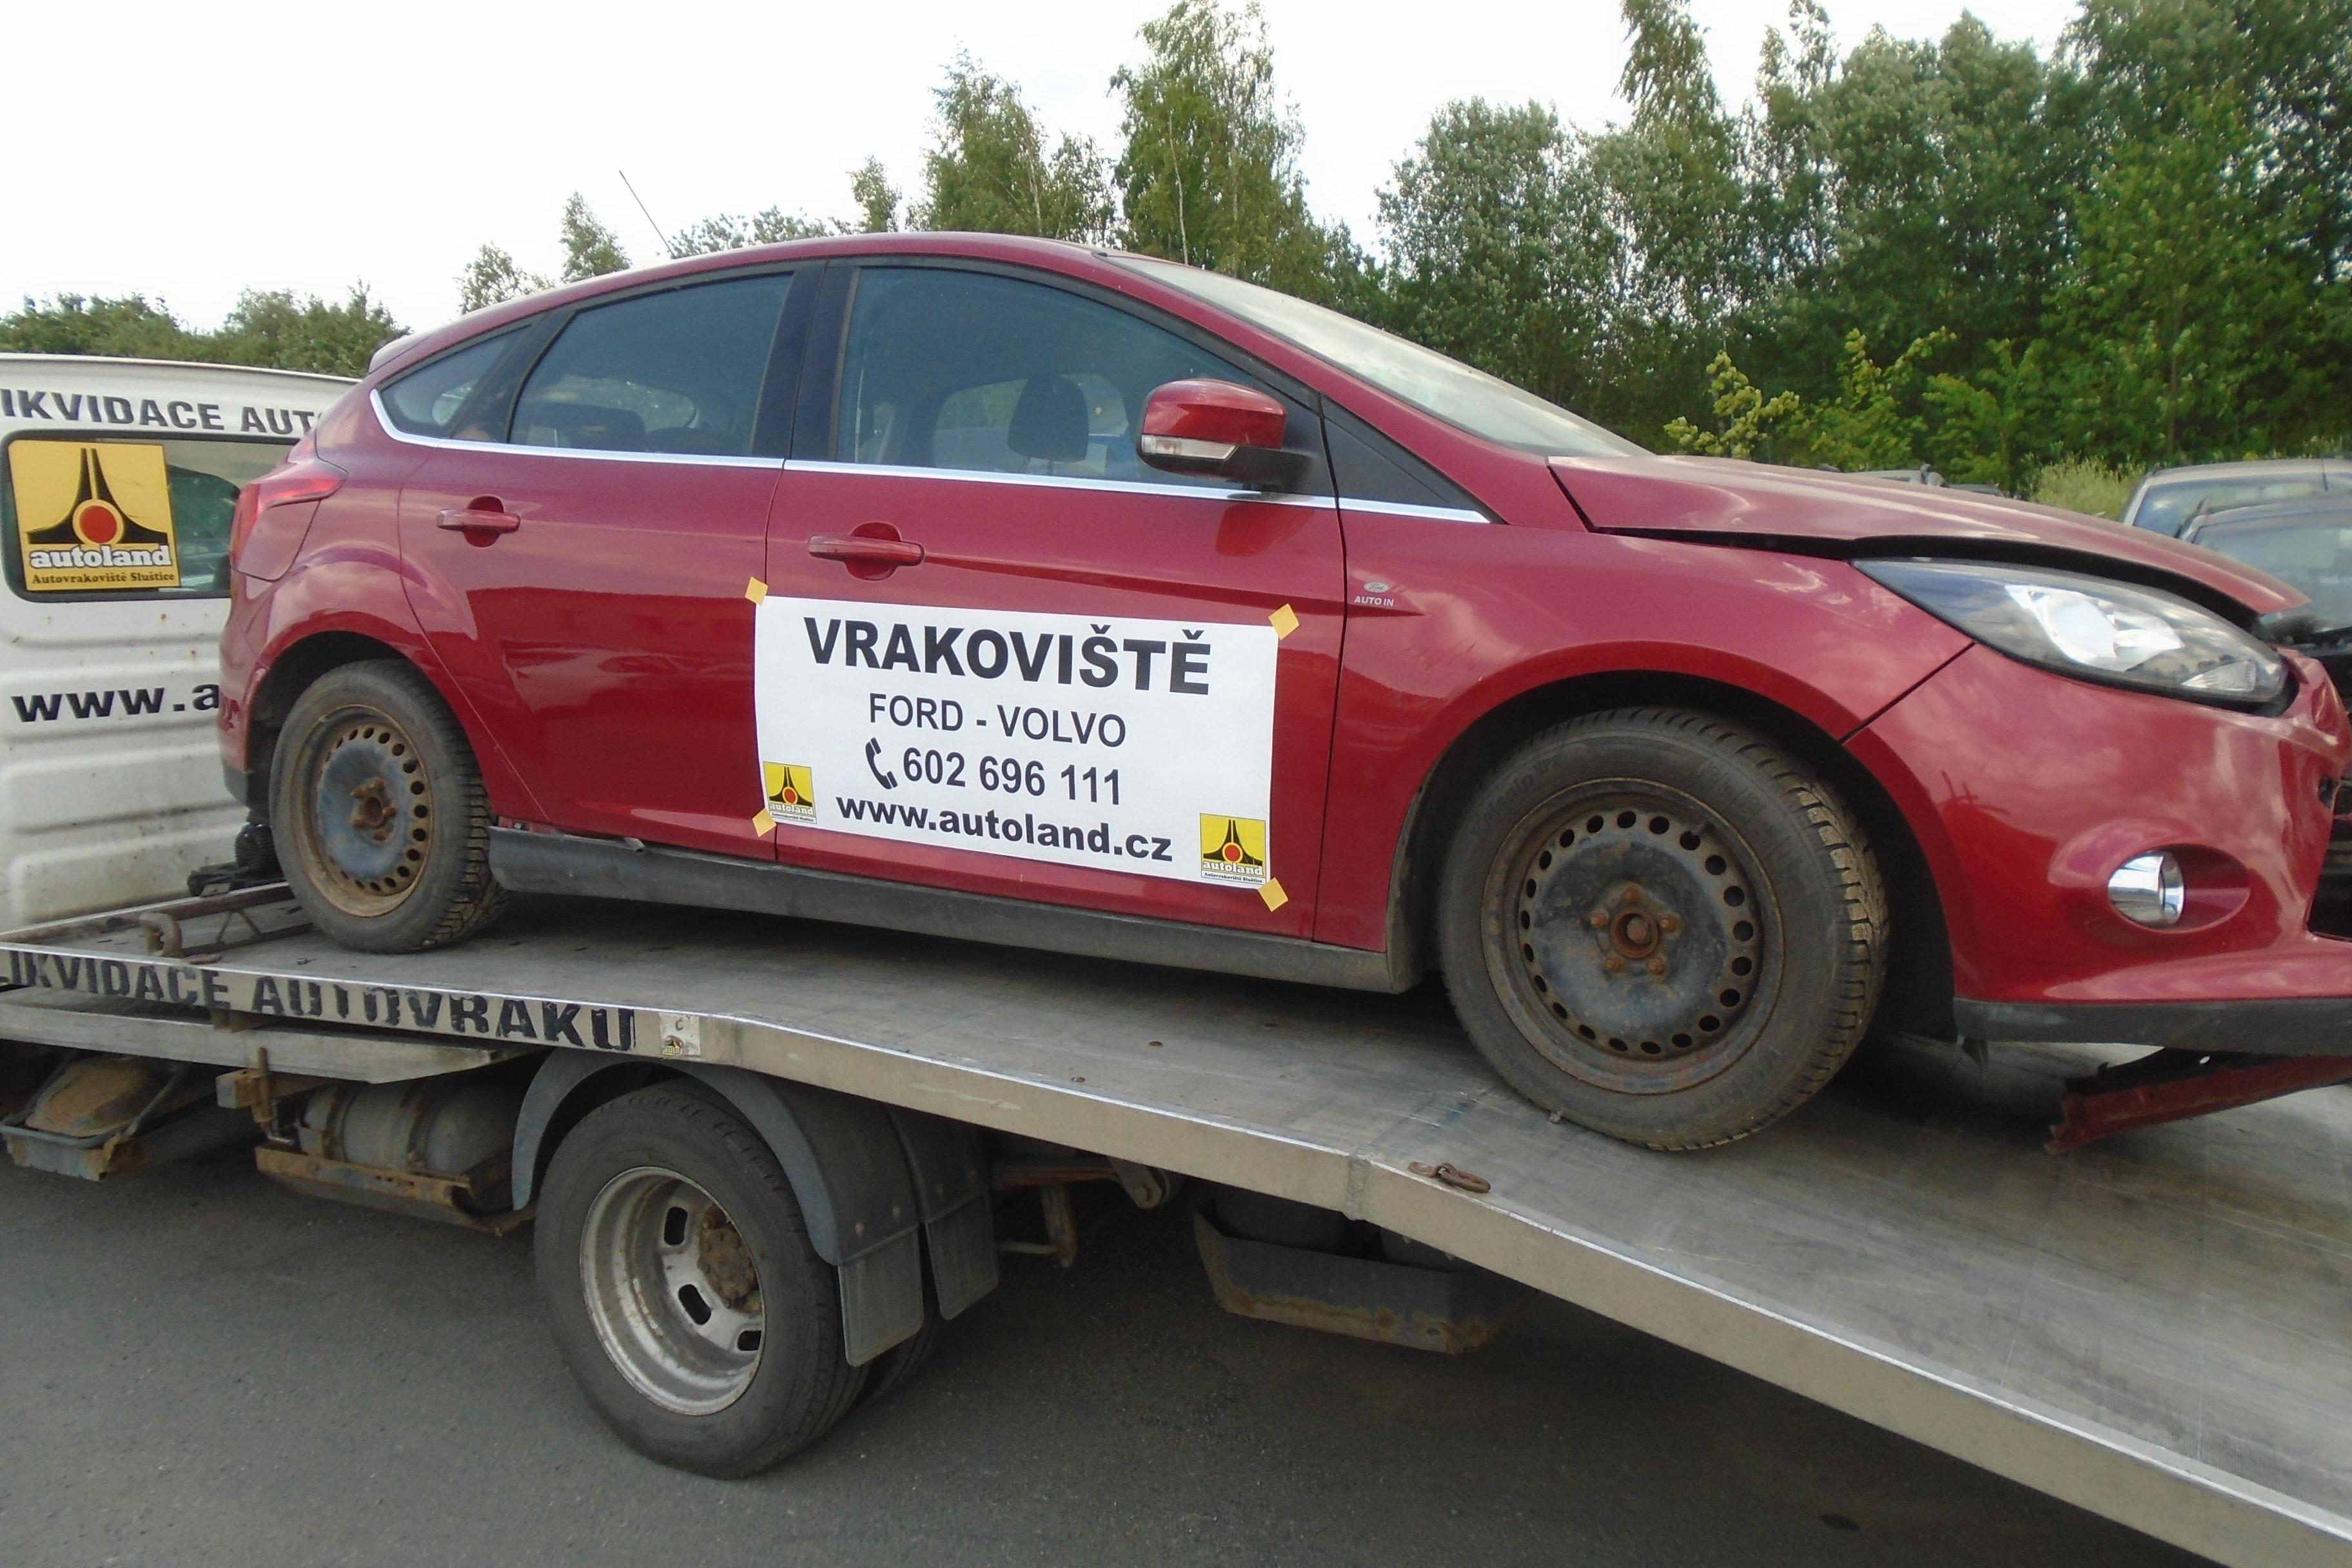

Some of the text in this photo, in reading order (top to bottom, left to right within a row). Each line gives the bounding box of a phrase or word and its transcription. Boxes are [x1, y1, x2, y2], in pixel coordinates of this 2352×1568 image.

[241, 406, 322, 435] AUT
[30, 545, 173, 568] autoland
[32, 571, 175, 583] Autovrakoviště Sluštice
[1354, 595, 1394, 606] AUTO IN
[803, 616, 1211, 696] VRAKOVIŠTĚ
[10, 683, 220, 723] www.a
[869, 692, 963, 731] FORD
[997, 704, 1126, 748] VOLVO
[903, 747, 1120, 806] 602 696 111
[769, 803, 814, 815] autoland
[836, 796, 1173, 862] www.autoland.cz
[1202, 861, 1264, 876] autoland
[0, 950, 231, 1010] IKVIDACE
